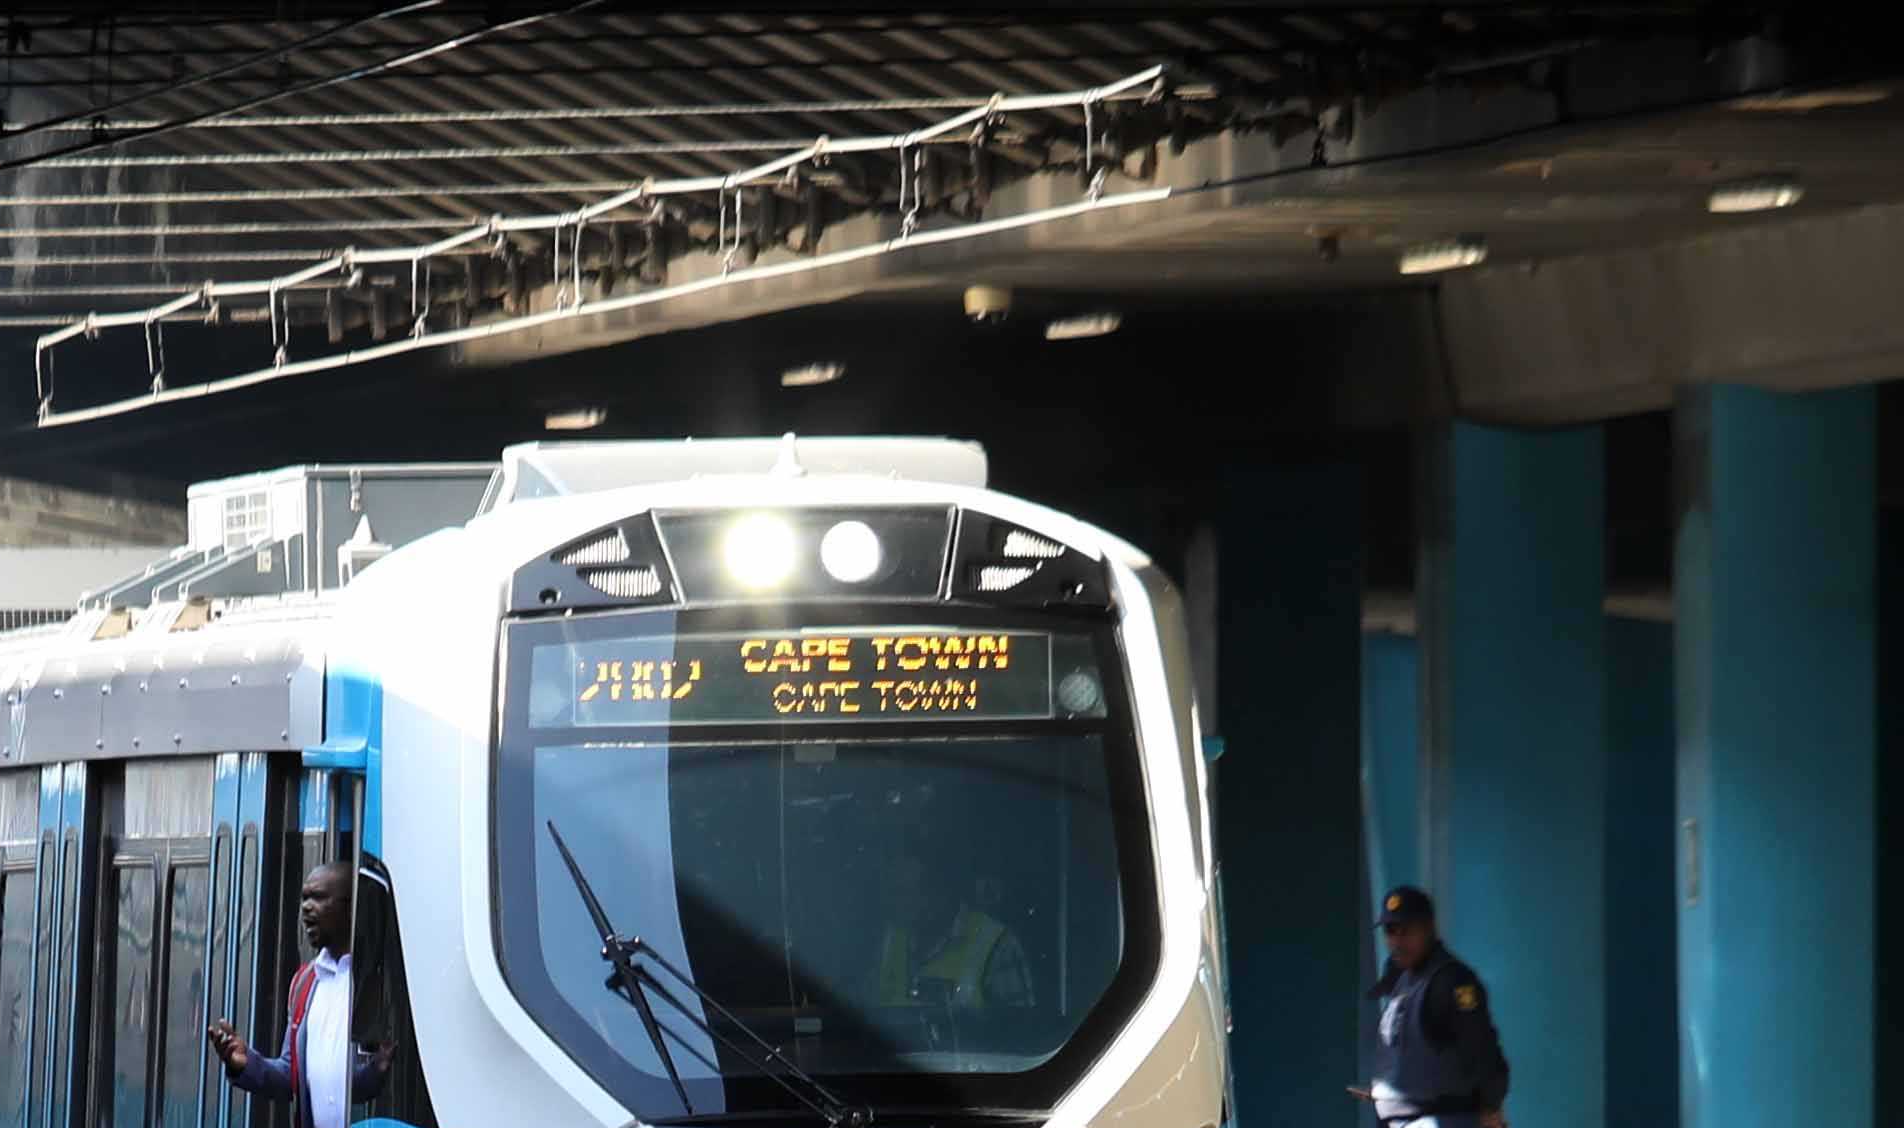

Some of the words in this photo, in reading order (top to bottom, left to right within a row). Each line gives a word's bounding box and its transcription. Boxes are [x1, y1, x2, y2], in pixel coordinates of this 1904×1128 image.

[741, 638, 850, 672] CAPE
[872, 635, 1008, 670] TOWN
[772, 681, 860, 712] CAPE
[872, 679, 976, 711] TOWN
